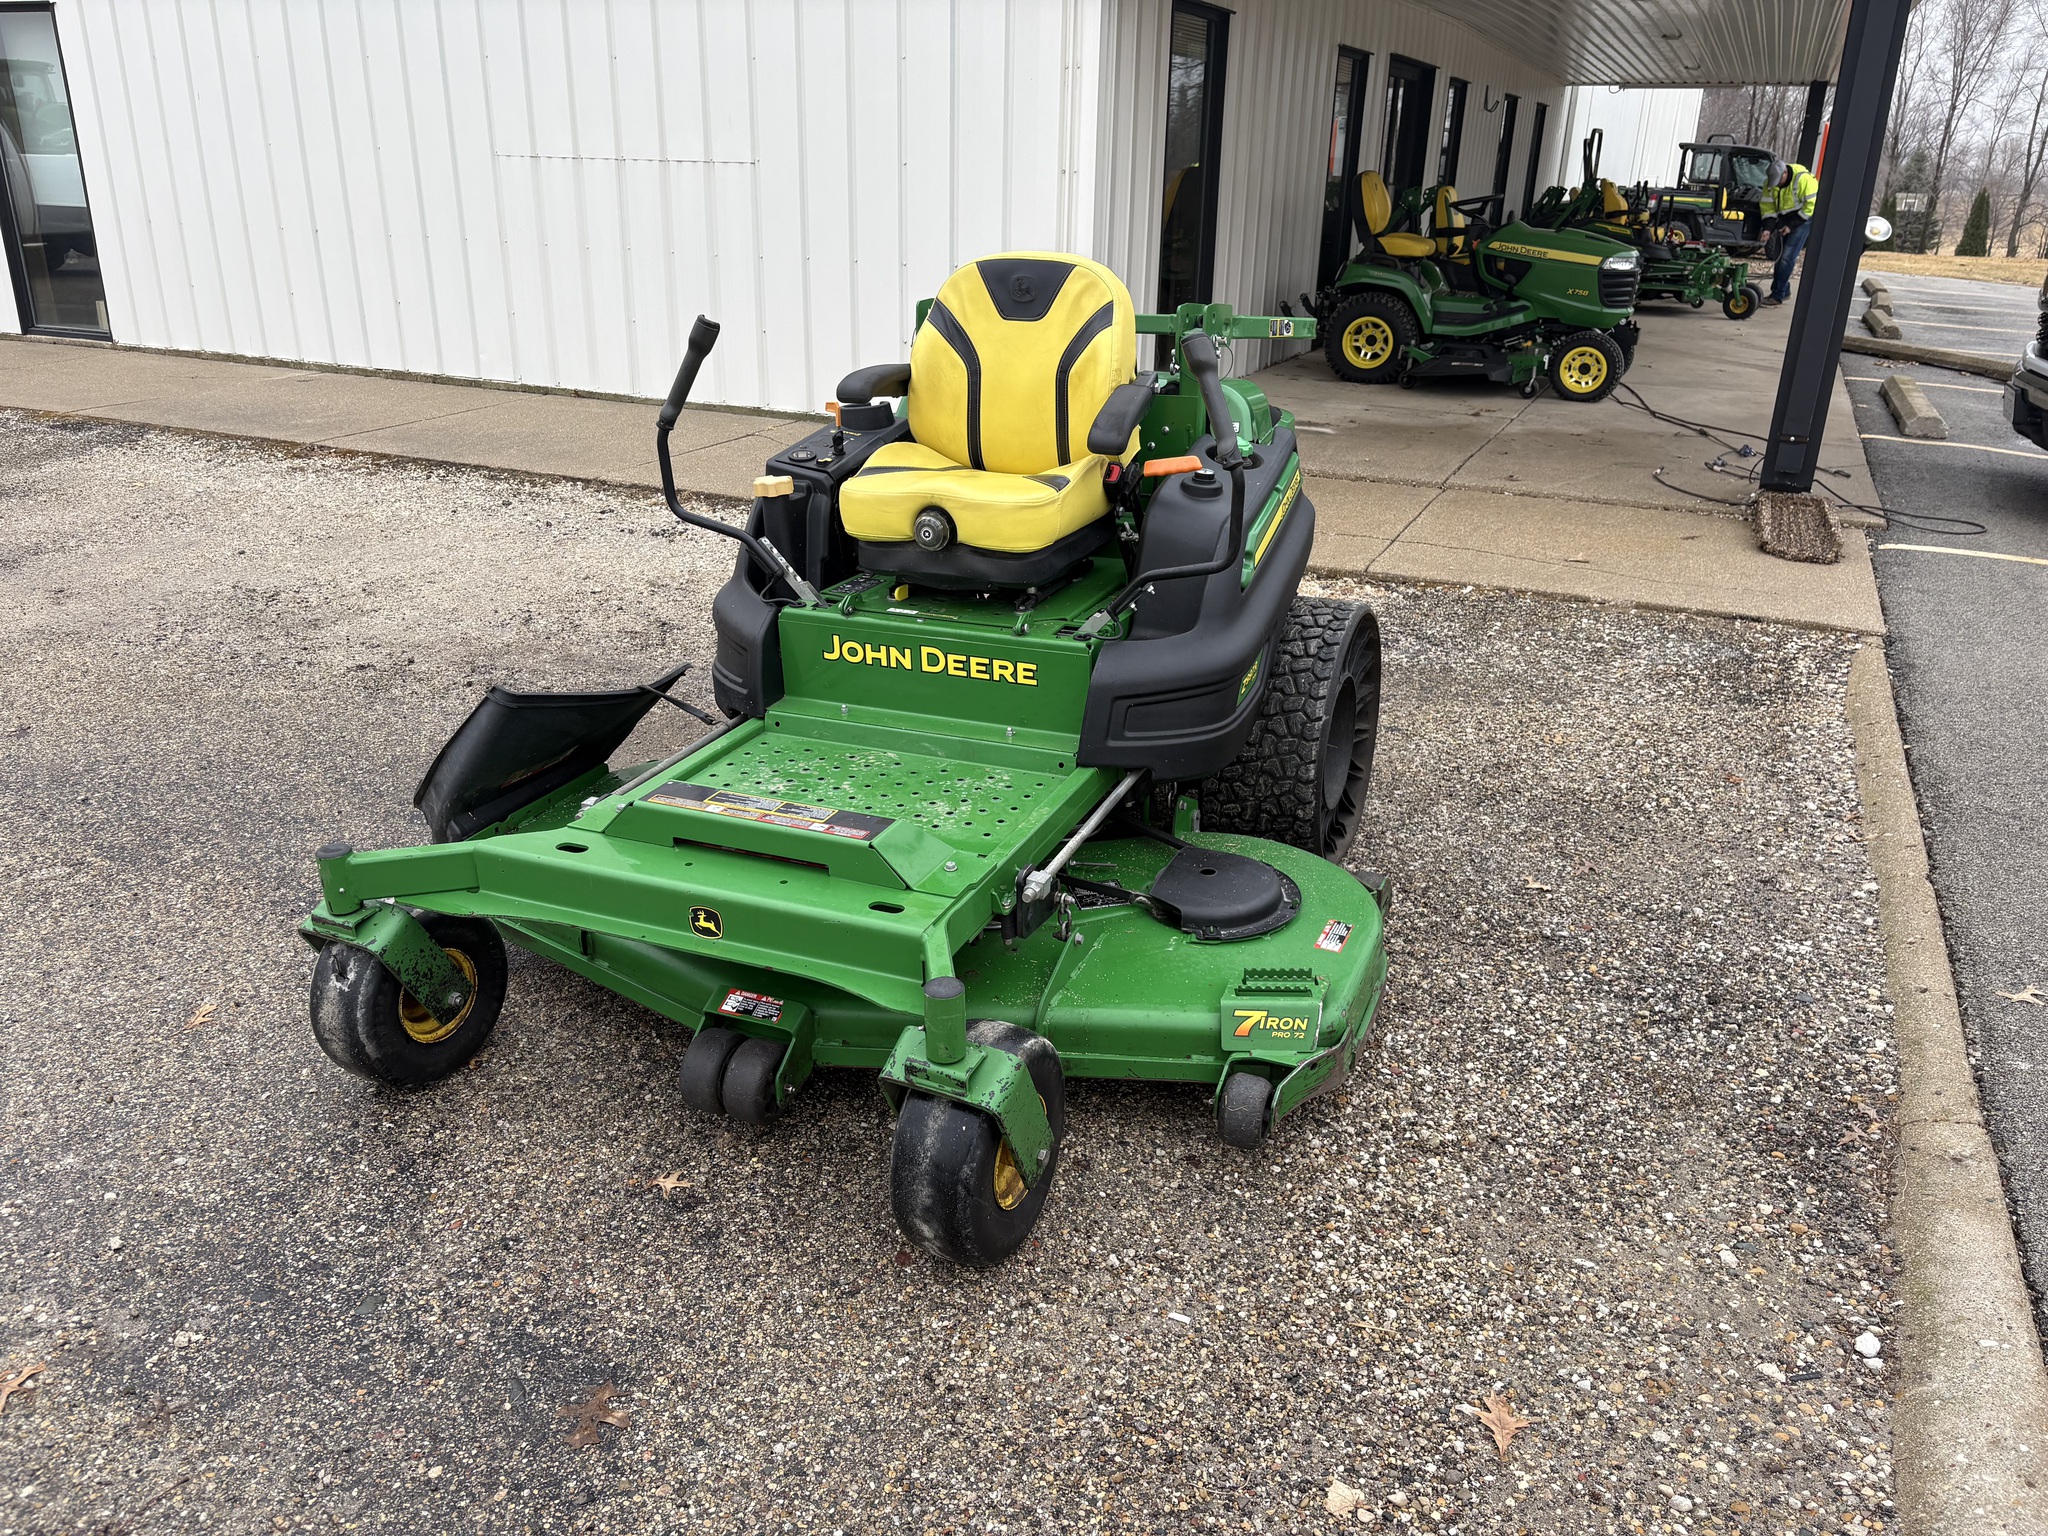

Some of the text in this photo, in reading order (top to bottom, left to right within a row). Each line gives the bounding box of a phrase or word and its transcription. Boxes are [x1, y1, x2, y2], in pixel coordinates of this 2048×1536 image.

[1495, 242, 1549, 258] JOHN DEERE
[1566, 288, 1590, 297] X758
[823, 634, 1039, 687] JOHN DEERE
